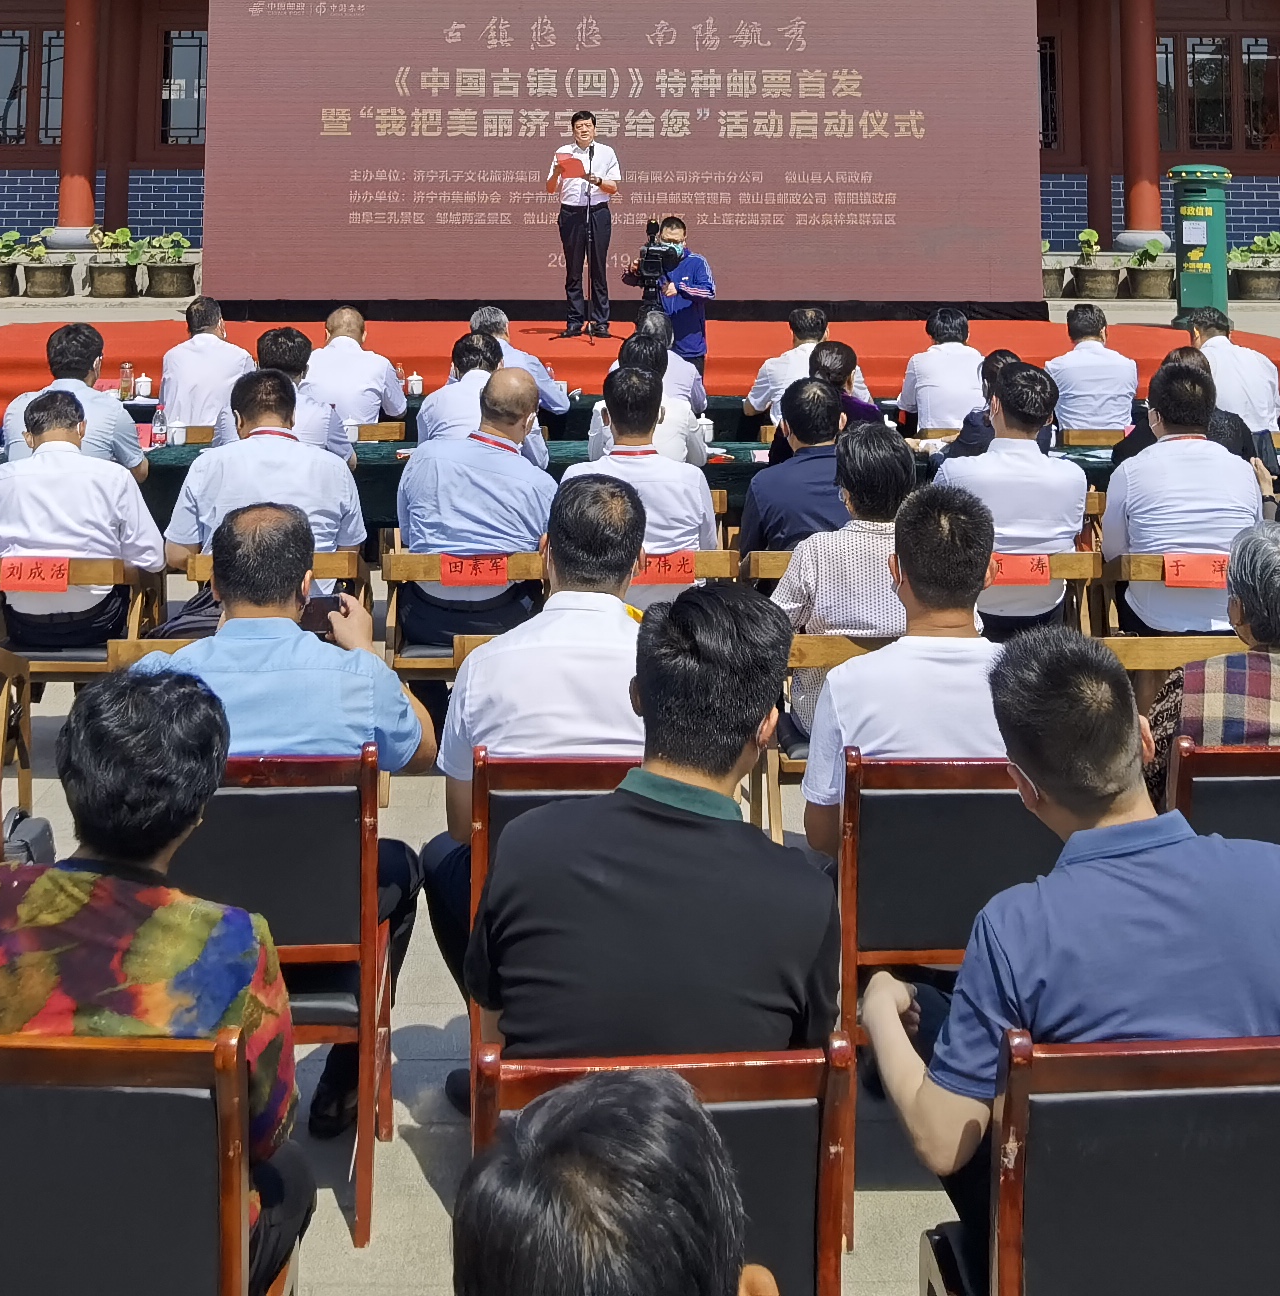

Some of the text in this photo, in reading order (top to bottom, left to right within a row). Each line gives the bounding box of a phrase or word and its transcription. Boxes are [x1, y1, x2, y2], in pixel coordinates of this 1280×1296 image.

[784, 170, 874, 185] 微山县人民政府
[834, 191, 897, 205] 南阳镇政府
[448, 556, 506, 577] 田素军
